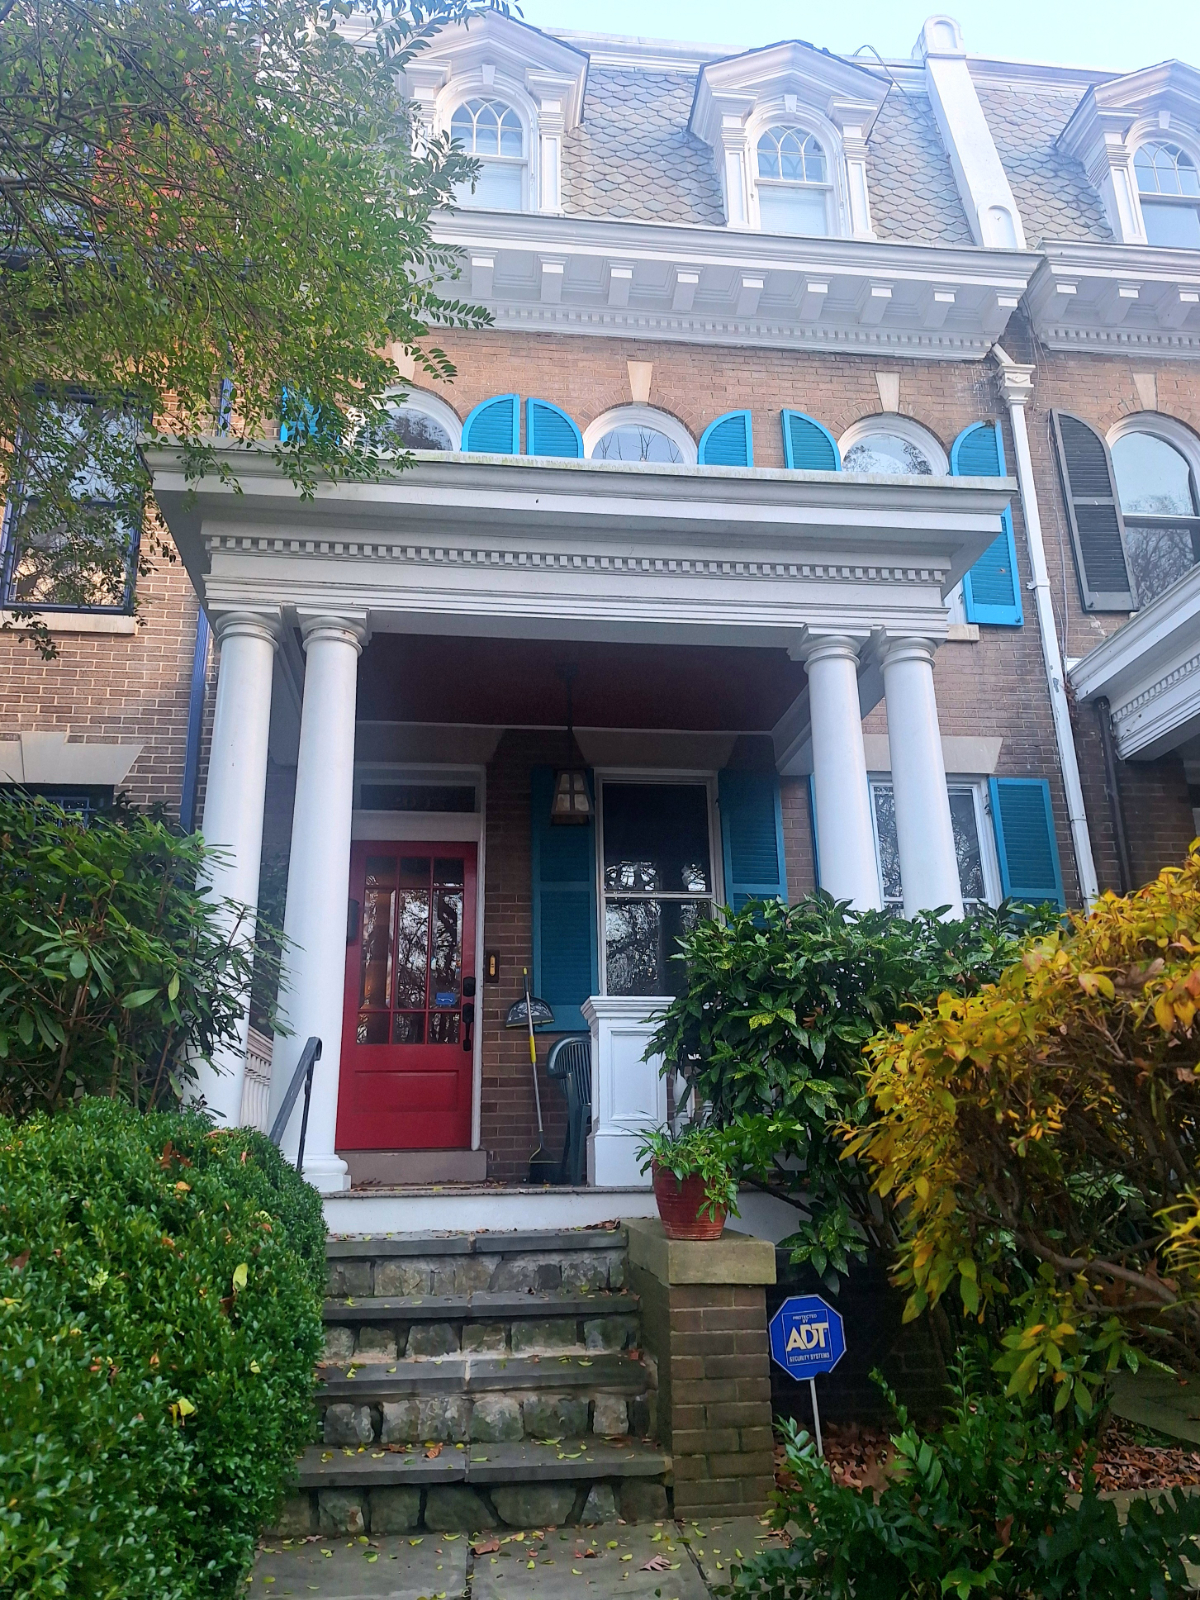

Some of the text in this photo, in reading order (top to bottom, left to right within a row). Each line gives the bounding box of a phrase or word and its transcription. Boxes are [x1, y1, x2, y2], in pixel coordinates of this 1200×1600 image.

[786, 1322, 829, 1351] ADT
[789, 1352, 830, 1363] SECURITY SYSTEMS
